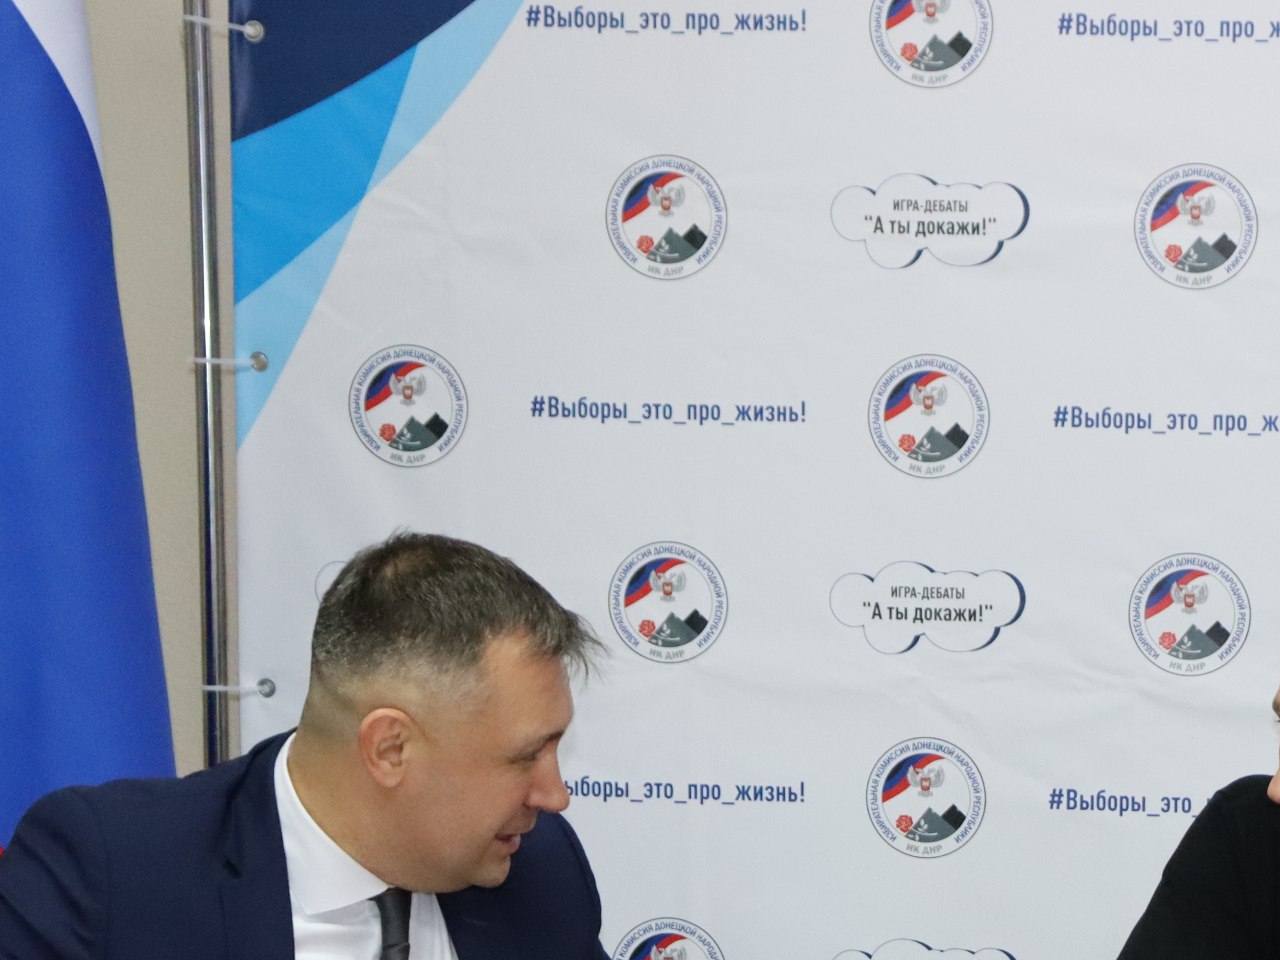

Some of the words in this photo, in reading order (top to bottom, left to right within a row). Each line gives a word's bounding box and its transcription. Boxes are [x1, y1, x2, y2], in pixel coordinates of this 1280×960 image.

[526, 5, 806, 35] #Выборы_это_про_жизнь!
[874, 5, 902, 72] ИЗБИРАТЕЛЬНАЯ
[960, 21, 988, 72] РЕСПУБЛИКИ
[615, 163, 650, 197] КОМИССИЯ
[652, 159, 696, 175] ДОНЕЦКОЙ
[1182, 168, 1227, 184] ДОНЕЦКОЙ
[695, 172, 724, 213] НАРОДНОЙ
[893, 199, 968, 213] ИГРА-ДЕБАТЫ
[1144, 172, 1180, 206] КОМИССИЯ
[1226, 181, 1254, 223] НАРОДНОЙ
[611, 198, 638, 264] ИЗБИРАТЕЛЬНАЯ
[695, 215, 723, 264] РЕСПУБЛИКИ
[889, 220, 910, 234] ты
[915, 218, 996, 238] докажи!"
[1139, 207, 1166, 273] ИЗБИРАТЕЛЬНАЯ
[1224, 224, 1253, 274] РЕСПУБЛИКИ
[358, 353, 392, 386] КОМИССИЯ
[394, 349, 436, 364] ДОНЕЦКОЙ
[915, 359, 958, 374] ДОНЕЦКОЙ
[436, 362, 464, 402] НАРОДНОЙ
[878, 362, 913, 396] КОМИССИЯ
[957, 372, 986, 412] НАРОДНОЙ
[354, 387, 381, 452] ИЗБИРАТЕЛЬНАЯ
[530, 395, 805, 426] #Выборы_это_про_жизнь!
[437, 404, 464, 452] РЕСПУБЛИКИ
[873, 397, 900, 463] ИЗБИРАТЕЛЬНАЯ
[957, 414, 985, 463] РЕСПУБЛИКИ
[390, 453, 403, 462] ИК
[406, 454, 426, 464] ДНР
[909, 464, 922, 473] ИК
[925, 464, 945, 475] ДНР
[618, 549, 652, 583] КОМИССИЯ
[654, 546, 697, 561] ДОНЕЦКОЙ
[1176, 557, 1220, 573] ДОНЕЦКОЙ
[696, 558, 724, 599] НАРОДНОЙ
[891, 586, 965, 600] ИГРА-ДЕБАТЫ
[1139, 561, 1174, 594] КОМИССИЯ
[1219, 570, 1247, 611] НАРОДНОЙ
[613, 583, 640, 648] ИЗБИРАТЕЛЬНАЯ
[696, 600, 723, 648] РЕСПУБЛИКИ
[887, 607, 908, 620] ты
[913, 604, 992, 624] докажи!"
[1133, 595, 1160, 660] ИЗБИРАТЕЛЬНАЯ
[1218, 612, 1246, 660] РЕСПУБЛИКИ
[649, 649, 662, 658] ИК
[665, 649, 685, 659] ДНР
[1169, 661, 1182, 670] ИК
[1185, 662, 1206, 672] ДНР
[876, 745, 910, 778] КОМИССИЯ
[912, 741, 955, 757] ДОНЕЦКОЙ
[565, 776, 806, 805] ыборы_это_про_жизнь!
[954, 754, 982, 794] НАРОДНОЙ
[871, 779, 897, 842] ИЗБИРАТЕЛЬНАЯ
[954, 796, 981, 843] РЕСПУБЛИКИ
[906, 844, 919, 853] ИК
[922, 845, 942, 854] ДНР
[620, 925, 653, 957] КОМИССИЯ
[655, 922, 697, 937] ДОНЕЦКОЙ
